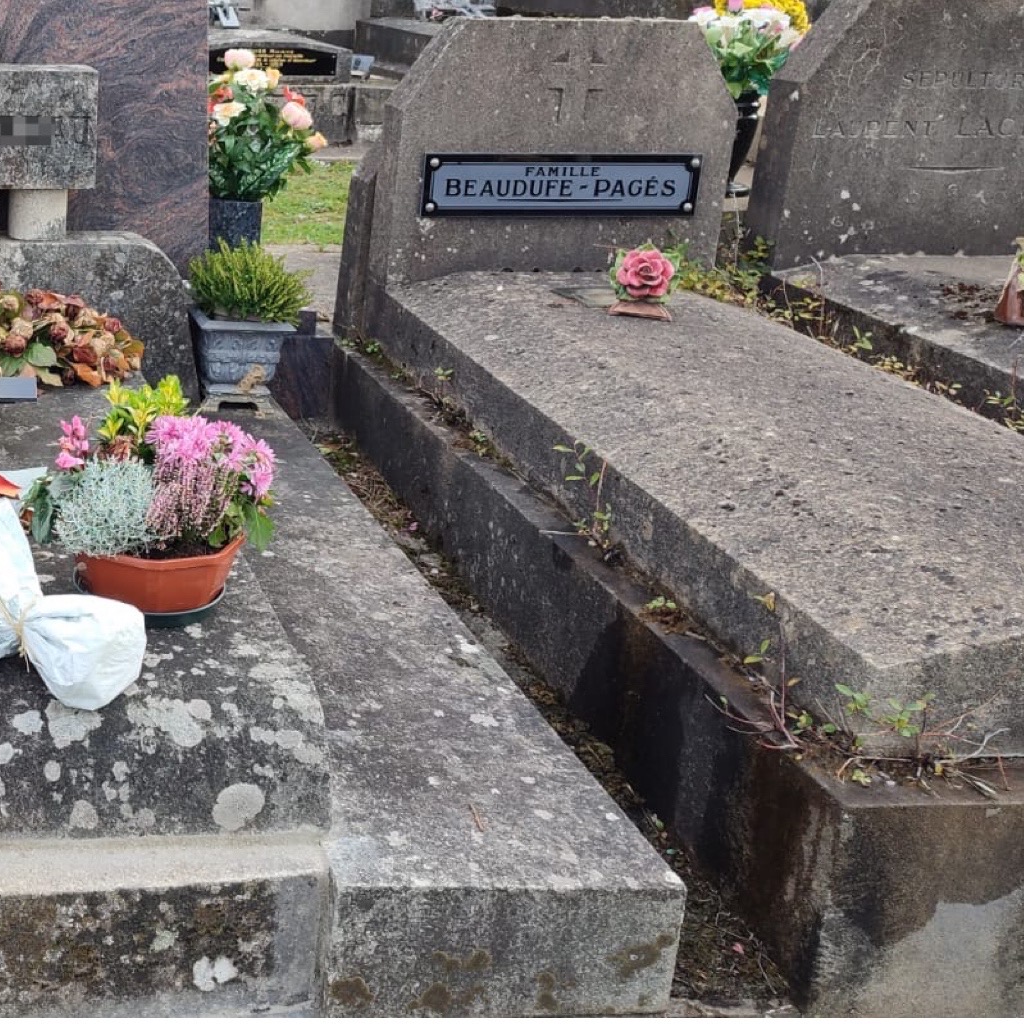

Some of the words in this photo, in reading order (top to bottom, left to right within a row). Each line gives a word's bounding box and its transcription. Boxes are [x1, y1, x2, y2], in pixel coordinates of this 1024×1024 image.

[812, 119, 941, 139] LAURENT
[954, 115, 1024, 139] LAC
[524, 166, 601, 177] FAMILLE
